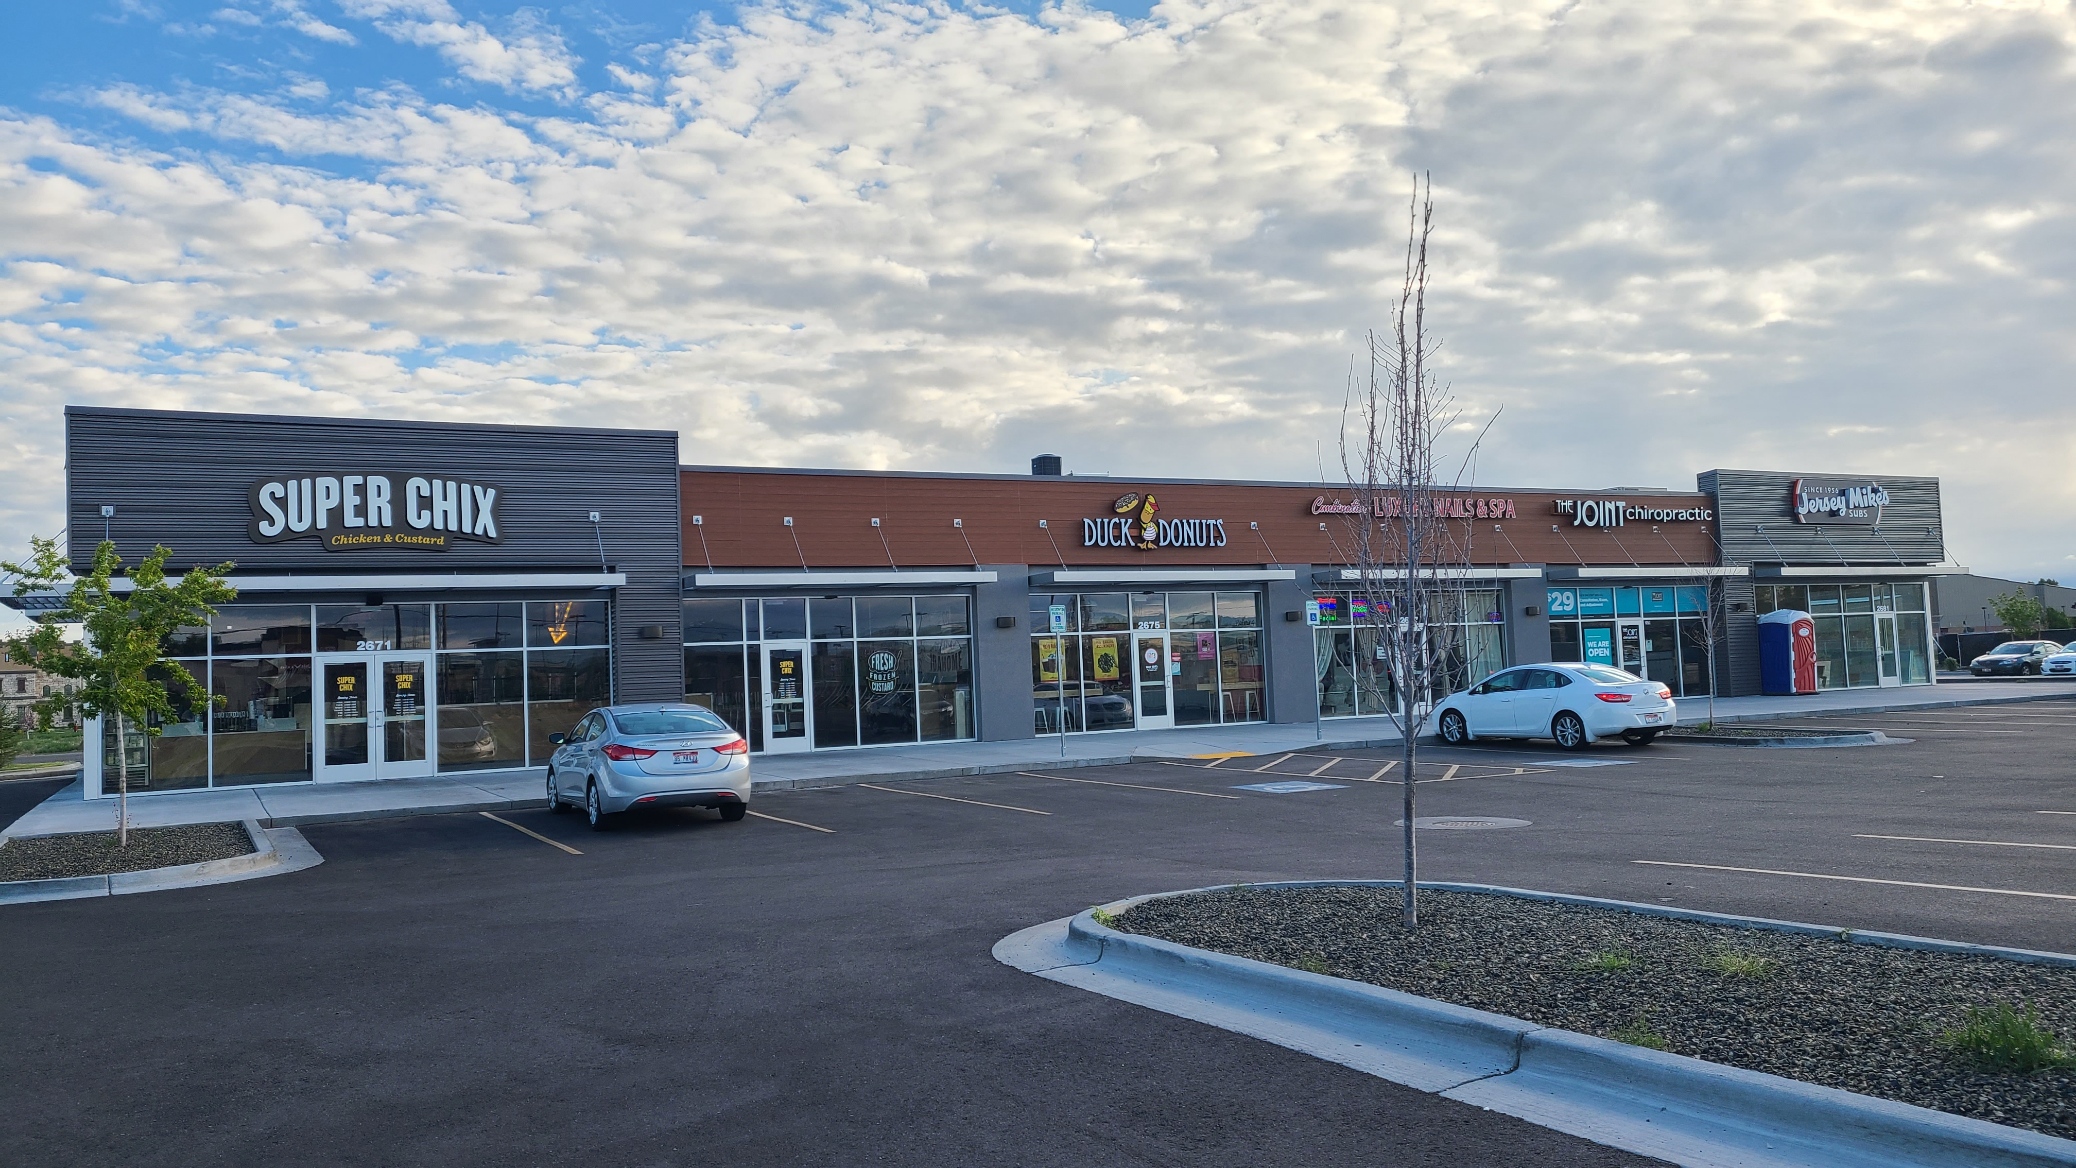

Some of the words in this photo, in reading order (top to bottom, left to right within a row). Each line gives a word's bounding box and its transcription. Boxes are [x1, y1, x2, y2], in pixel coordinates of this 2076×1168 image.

[258, 475, 392, 537] SUPER
[405, 476, 497, 538] CHIX
[1798, 492, 1847, 516] Jersey
[1849, 485, 1890, 509] Mike's
[1433, 497, 1475, 518] NAILS
[1477, 498, 1489, 518] &
[1489, 498, 1517, 519] SPA
[1555, 499, 1574, 514] THE
[1573, 500, 1626, 527] JOINT
[1626, 505, 1713, 523] chiropractic
[1849, 509, 1868, 518] SUBS
[1083, 517, 1136, 547] DUCK
[1157, 518, 1227, 547] DONUTS
[331, 534, 382, 546] Chicken
[384, 534, 393, 543] &
[395, 533, 445, 546] Custard
[1138, 621, 1160, 630] 2675
[356, 640, 391, 651] 2671
[1588, 648, 1610, 657] OPEN
[871, 653, 894, 670] FRESH
[337, 677, 355, 685] SUPER
[869, 672, 896, 680] FROZEN
[871, 681, 894, 692] CUSTARD
